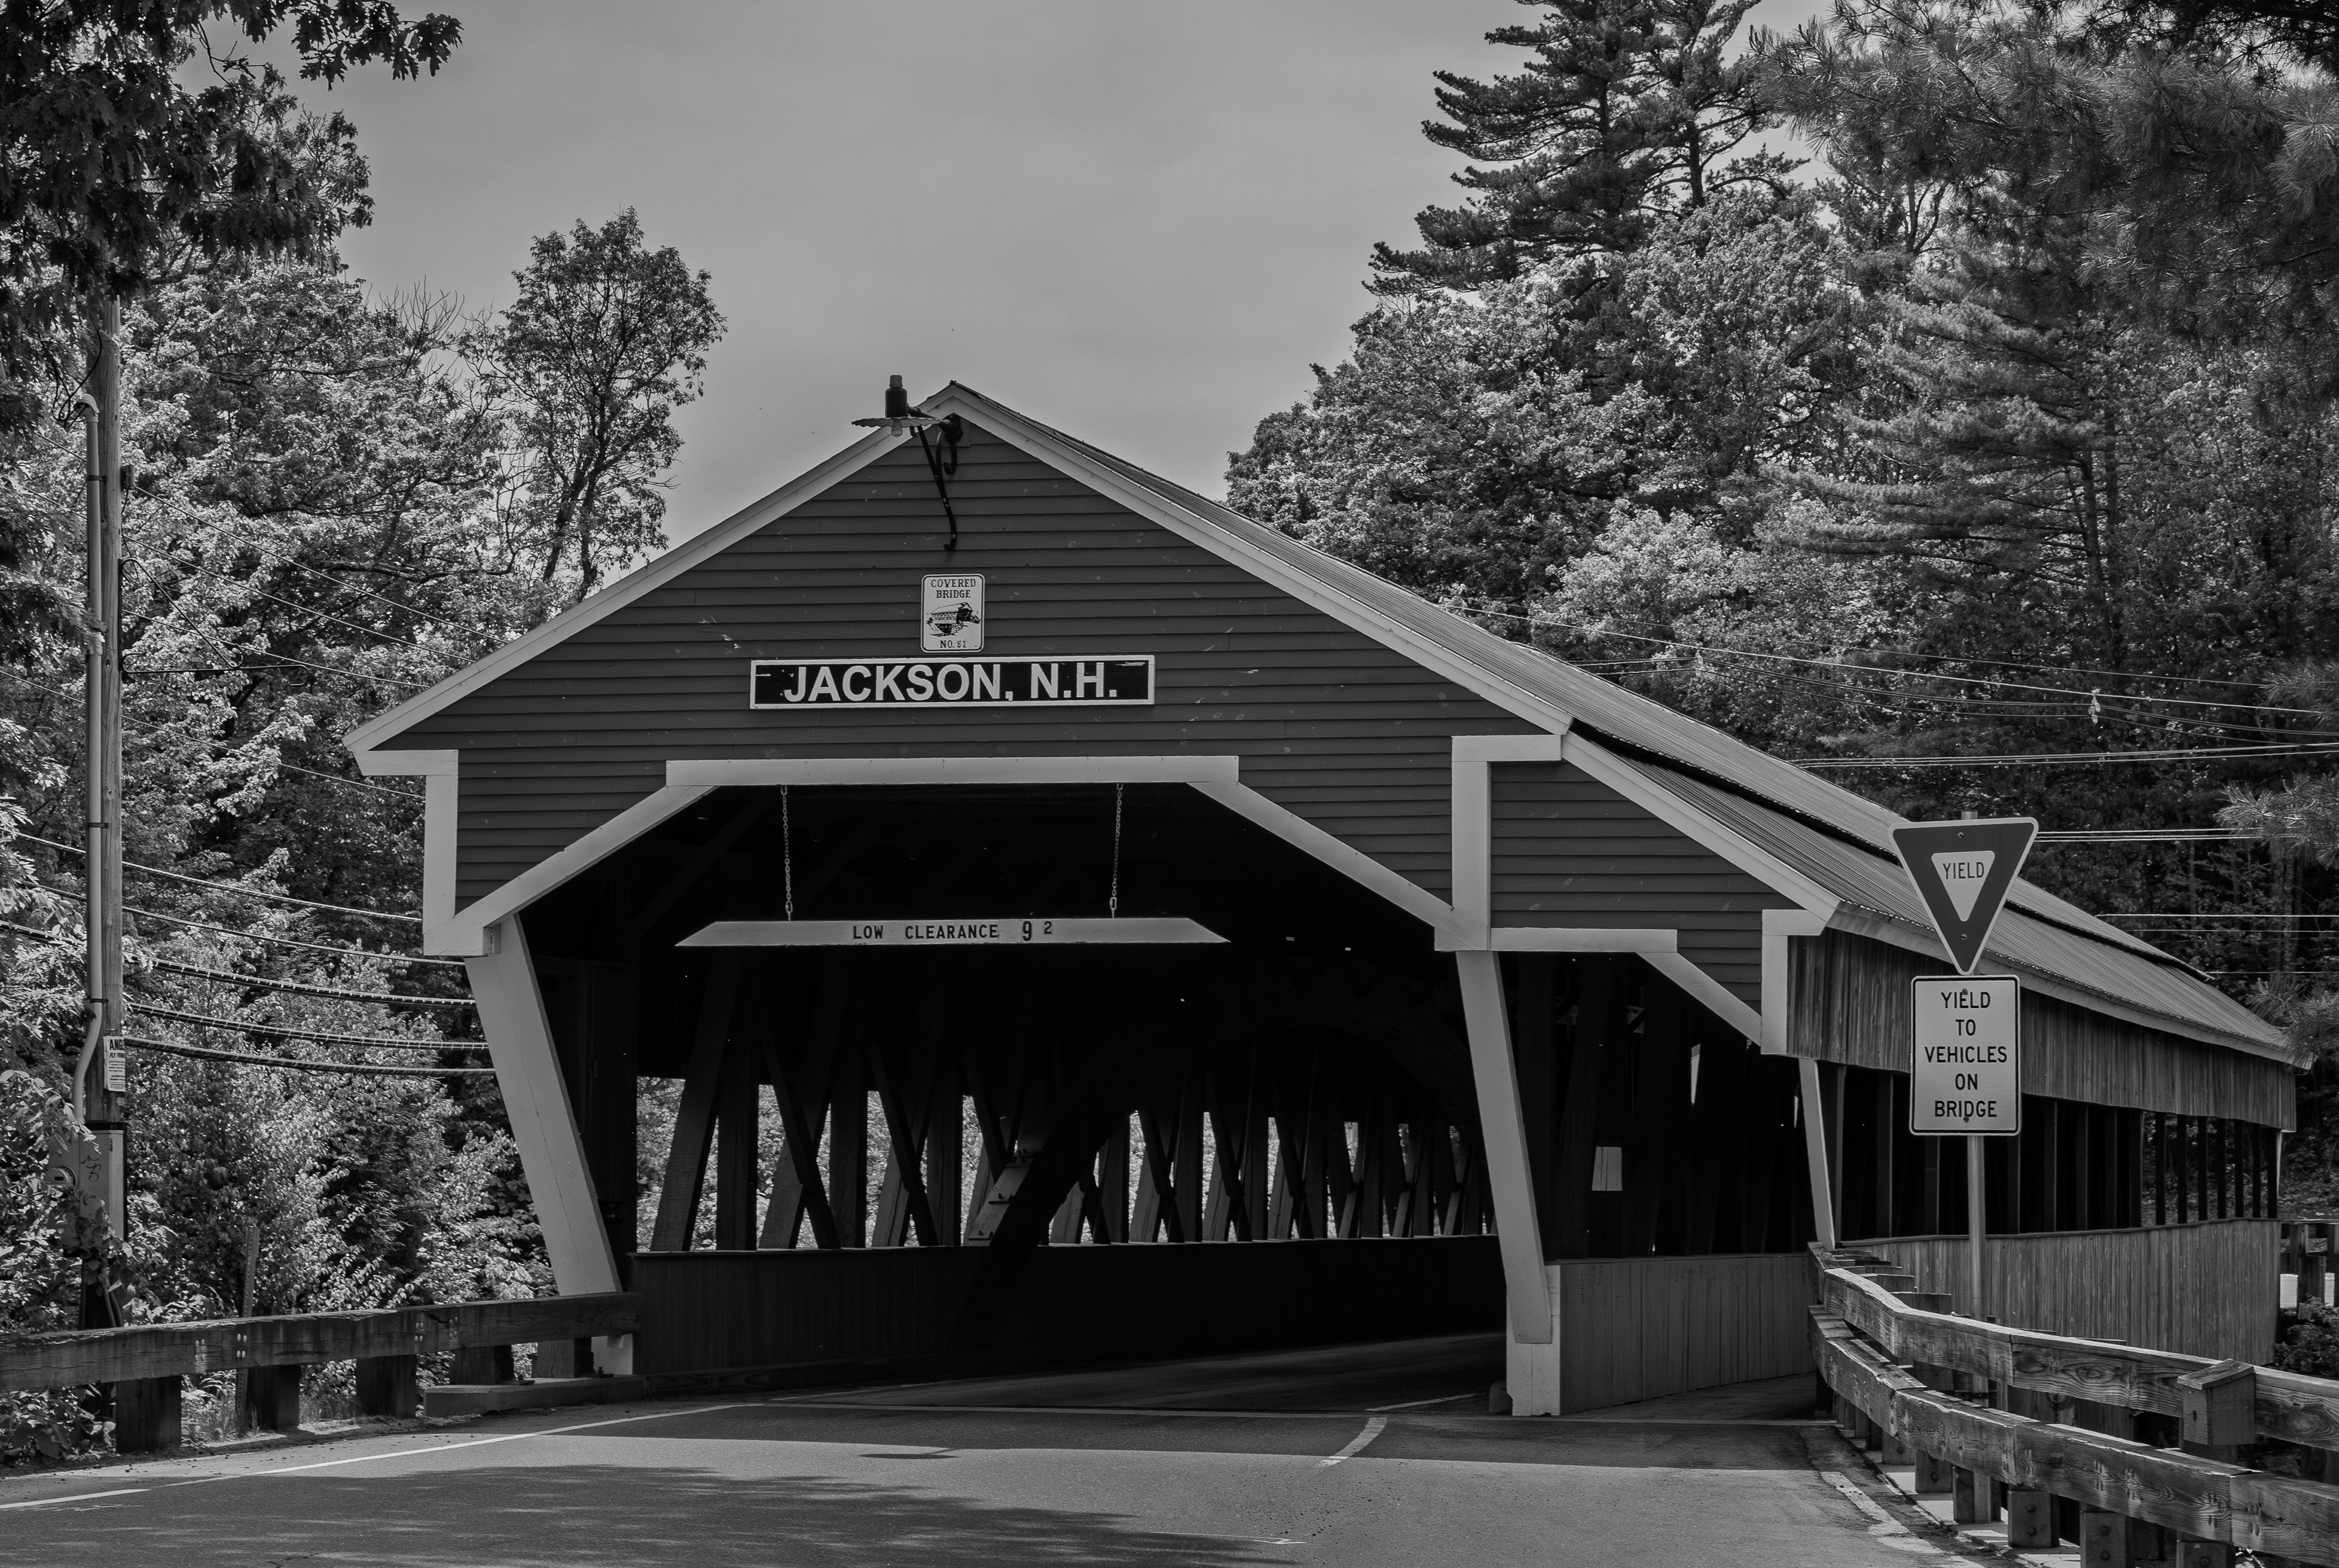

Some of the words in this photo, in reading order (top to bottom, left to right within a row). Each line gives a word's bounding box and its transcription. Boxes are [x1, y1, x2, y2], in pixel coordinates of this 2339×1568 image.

[931, 579, 976, 588] COVERED
[936, 590, 971, 598] BRIDGE
[783, 664, 1014, 702] JACKSON,
[1031, 662, 1117, 698] N.H.
[1942, 861, 1985, 880] YIELD
[853, 925, 884, 939] LOW
[905, 924, 999, 939] CLEARANCE
[1022, 920, 1032, 942] 9
[1940, 992, 1991, 1009] YIELD
[1955, 1019, 1977, 1036] TO
[1924, 1046, 2007, 1064] VEHICLES
[1955, 1074, 1978, 1091] ON
[1935, 1101, 1997, 1118] BRIDGE
